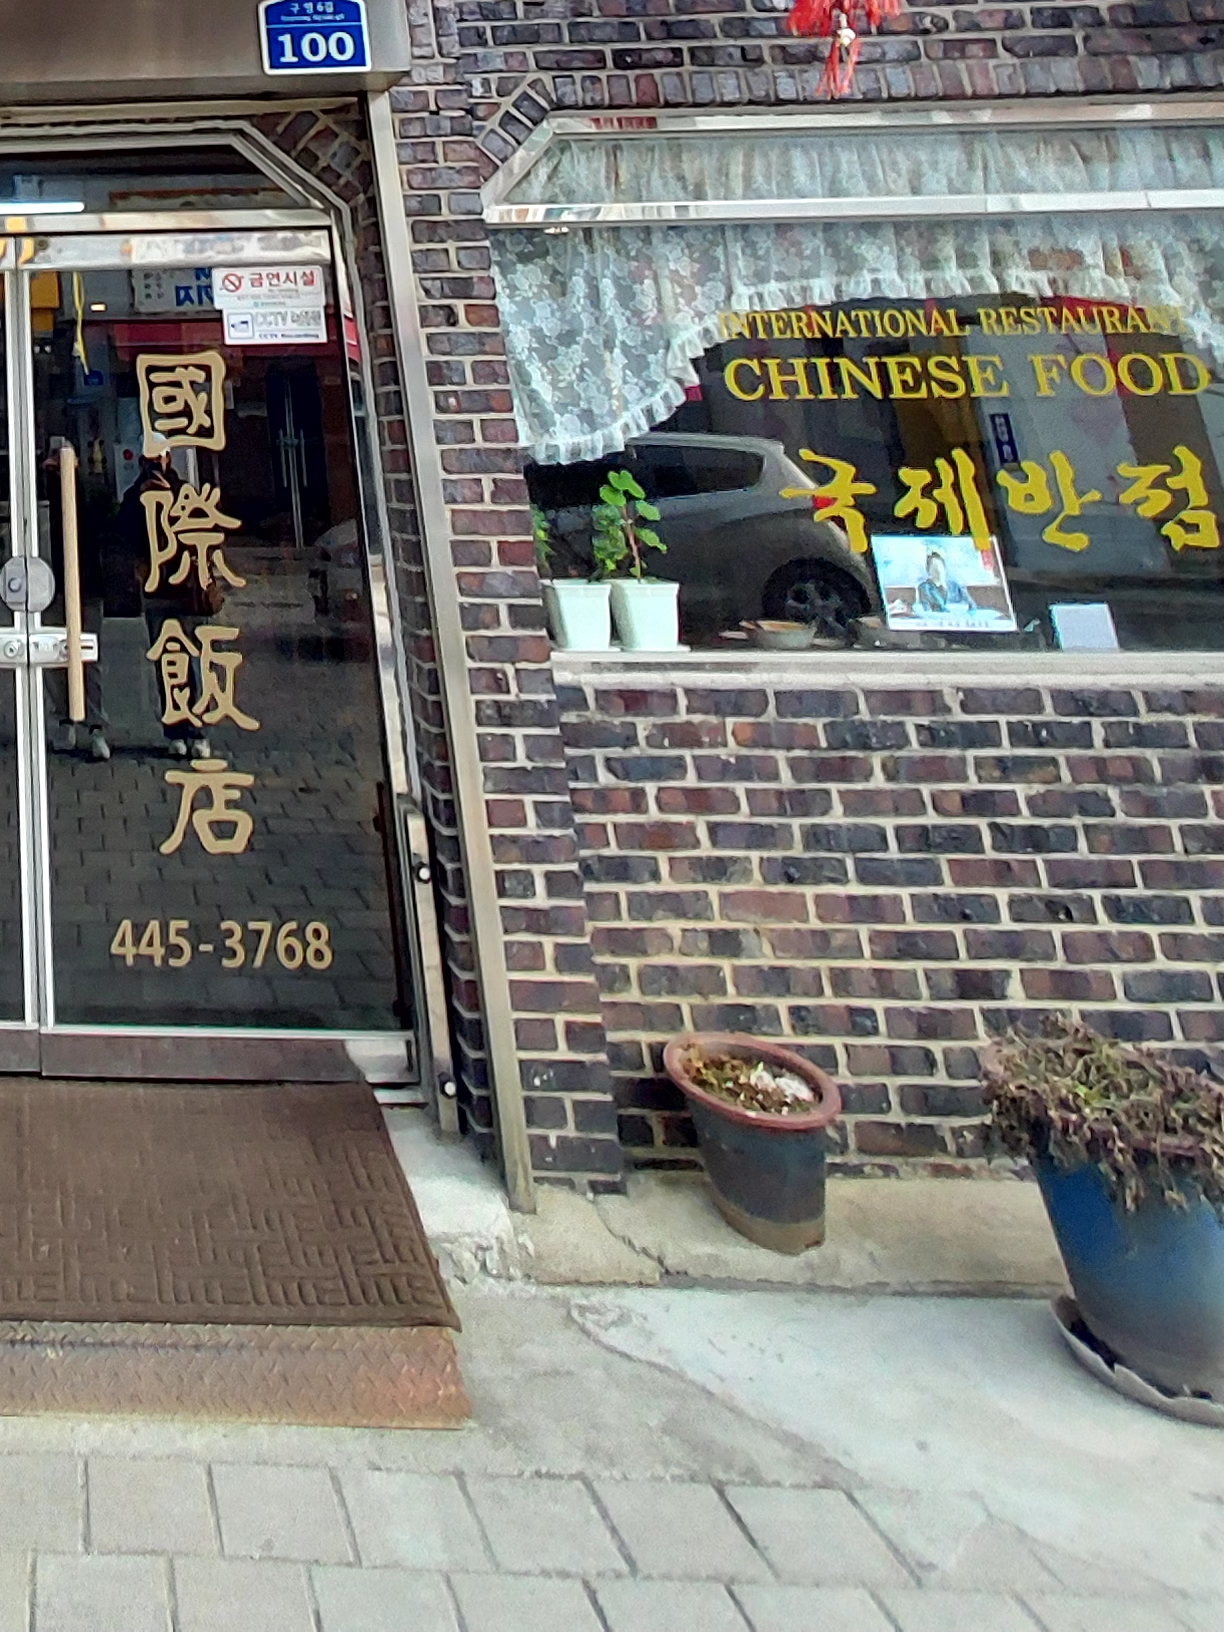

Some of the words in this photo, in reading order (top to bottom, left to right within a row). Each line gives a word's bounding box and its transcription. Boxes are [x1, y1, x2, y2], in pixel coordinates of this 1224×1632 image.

[277, 31, 355, 63] 100
[249, 270, 315, 287] 금연시설
[717, 308, 971, 340] INTERNATIONAL
[724, 354, 1010, 402] CHINESE
[1029, 352, 1212, 398] FOOD
[779, 444, 1221, 552] 국제반점
[136, 351, 262, 856] 國際飯店
[110, 918, 333, 970] 445-3768
